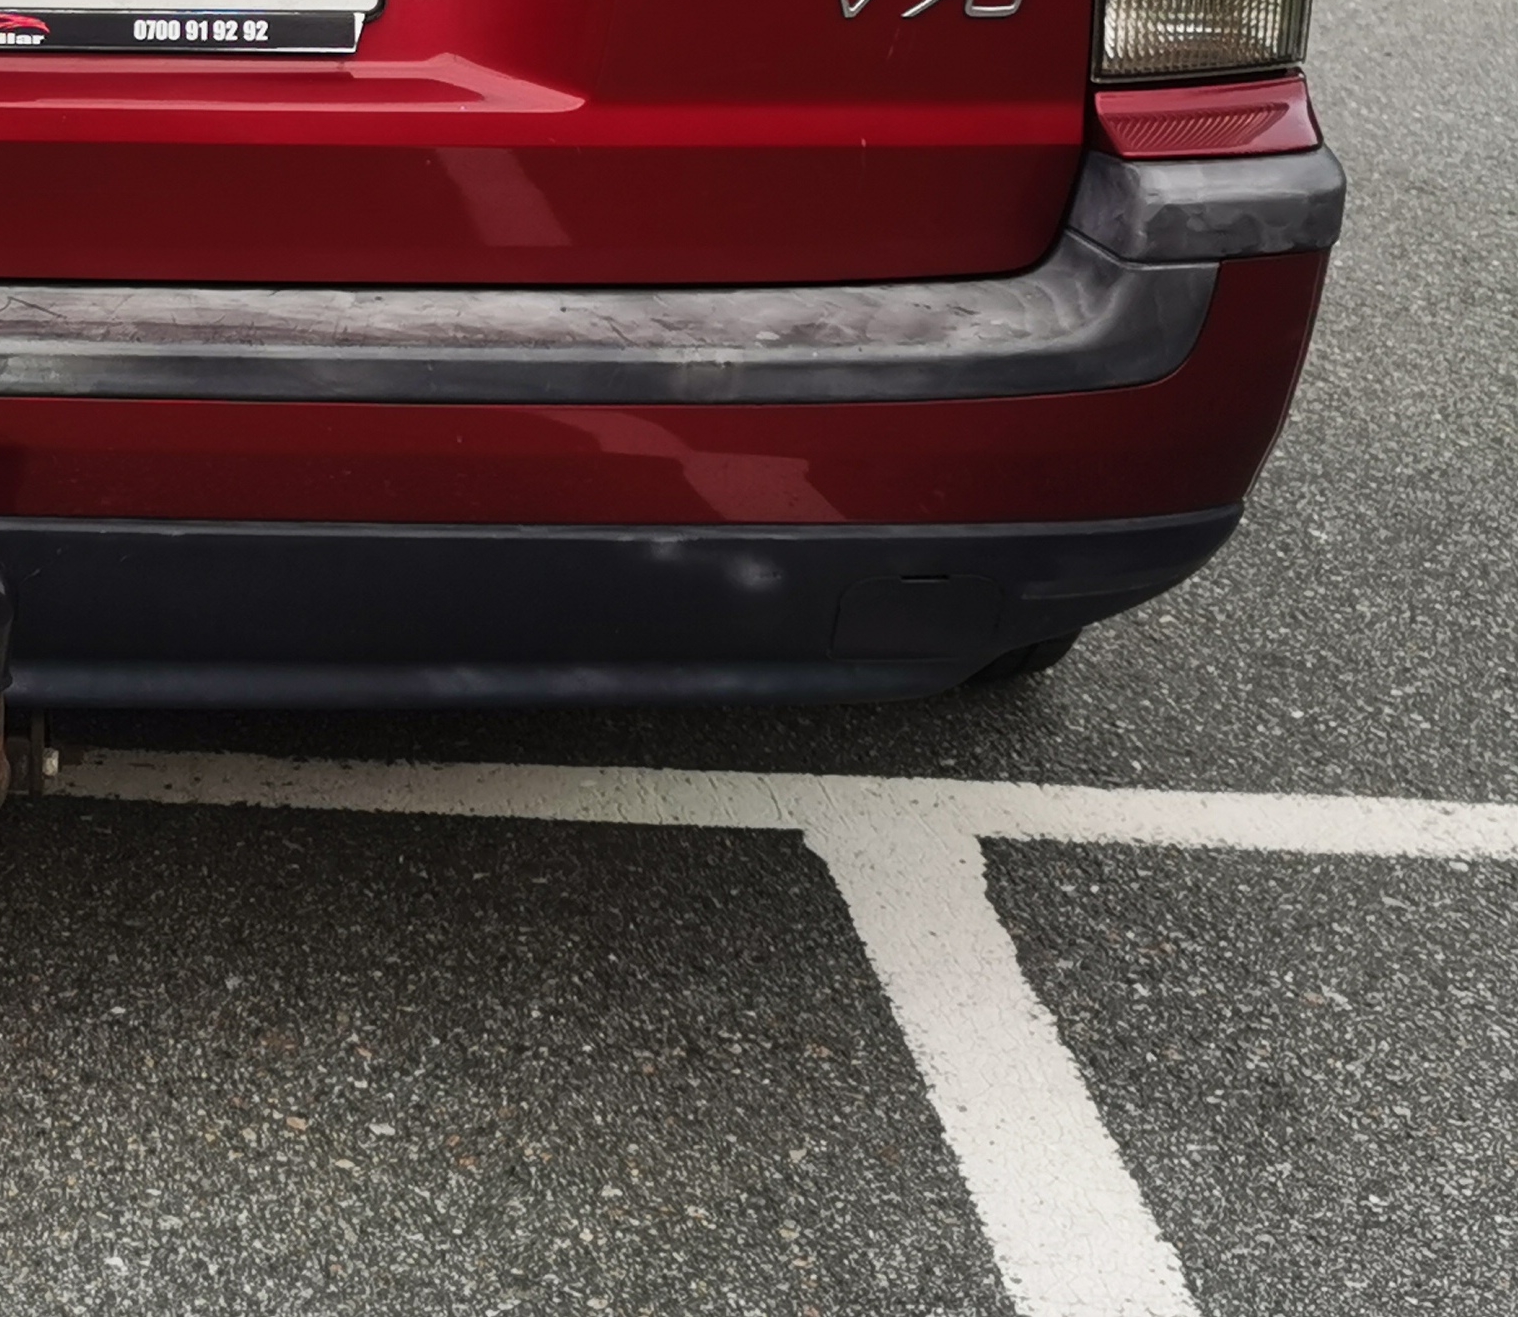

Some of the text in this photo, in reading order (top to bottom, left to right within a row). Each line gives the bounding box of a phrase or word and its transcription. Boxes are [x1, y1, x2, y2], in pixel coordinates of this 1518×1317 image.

[134, 19, 268, 41] 0700 91 92 92
